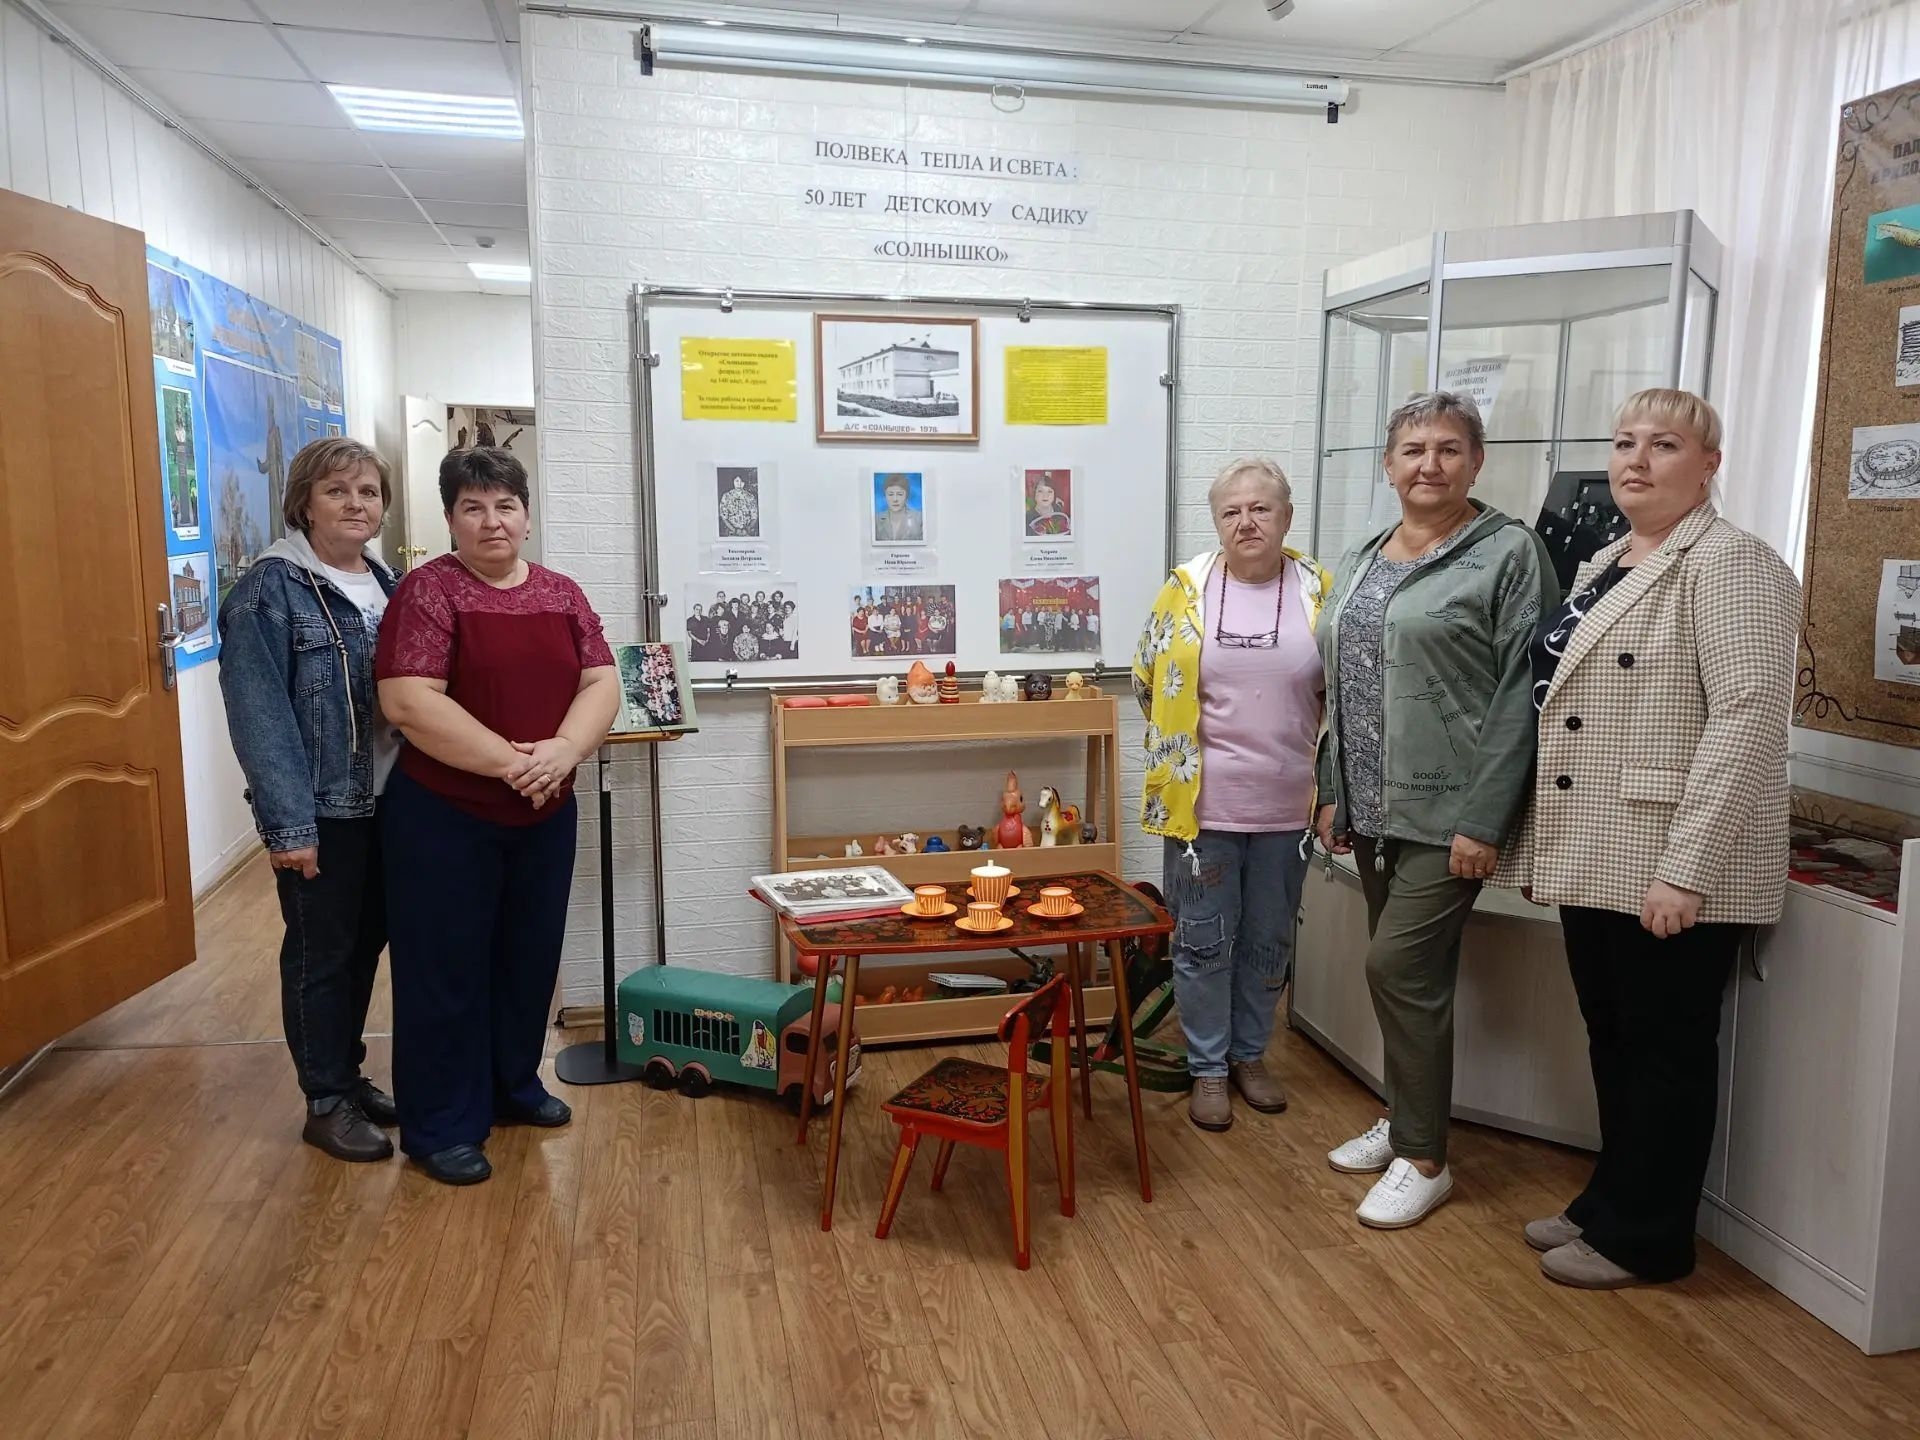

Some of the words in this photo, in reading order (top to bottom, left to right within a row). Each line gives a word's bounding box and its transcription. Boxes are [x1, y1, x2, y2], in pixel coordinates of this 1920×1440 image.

[816, 141, 909, 166] ПОЛВЕКА
[921, 151, 984, 171] ТЕПЛА
[990, 156, 1002, 172] И
[1007, 158, 1067, 178] СВЕТА
[804, 189, 825, 206] 50
[829, 191, 867, 208] ЛЕТ
[884, 195, 992, 219] ДЕТСКОМУ
[1011, 204, 1088, 225] САДИКУ
[874, 240, 1009, 263] «СОЛНЫШКО»
[1413, 772, 1441, 780] GOOD
